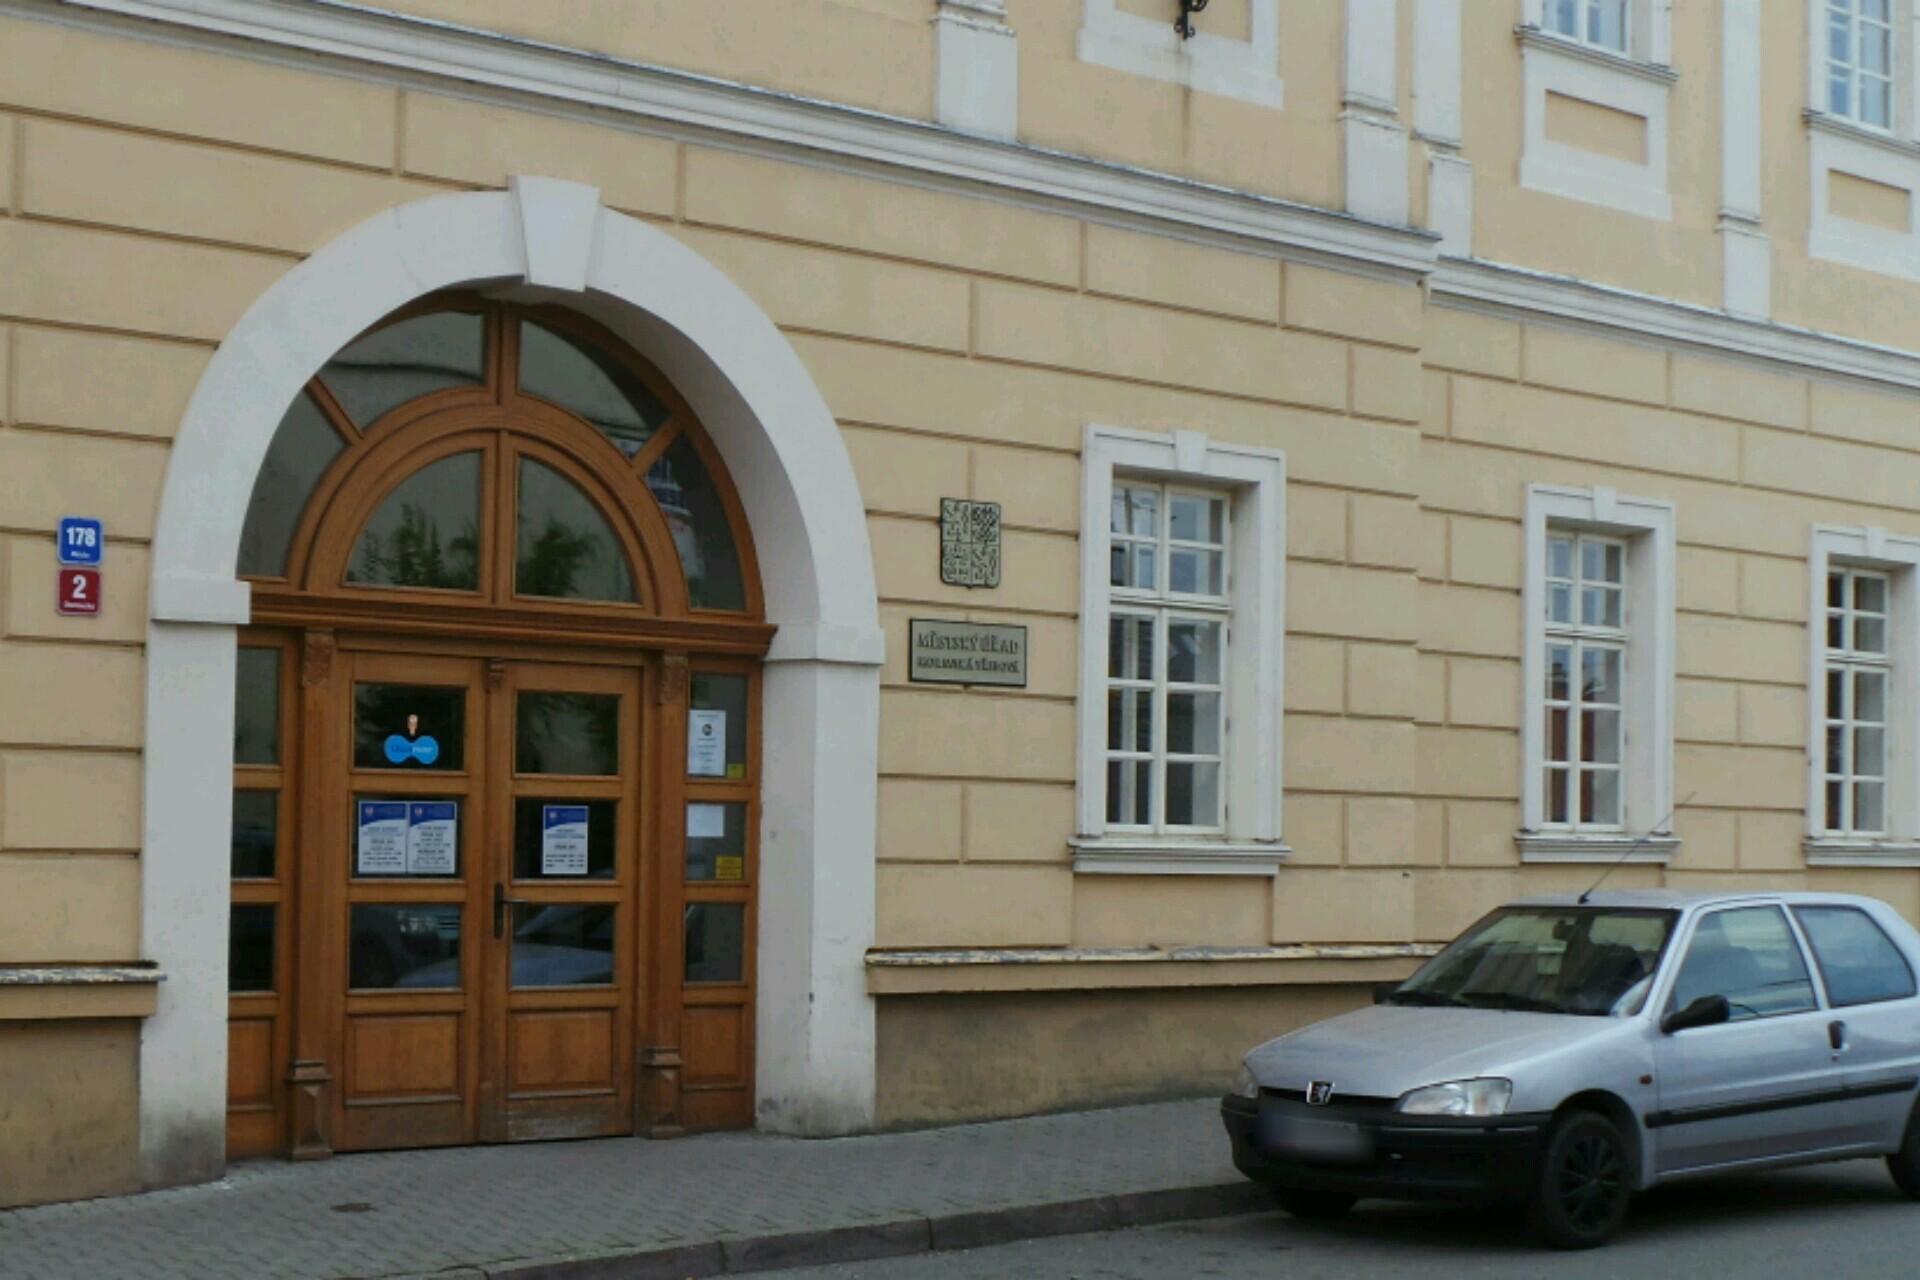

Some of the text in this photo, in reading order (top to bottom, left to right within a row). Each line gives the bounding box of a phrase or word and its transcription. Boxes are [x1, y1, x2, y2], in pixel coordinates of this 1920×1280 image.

[66, 526, 96, 547] 178
[72, 574, 87, 599] 2
[917, 630, 977, 652] MĚSTSKÝ
